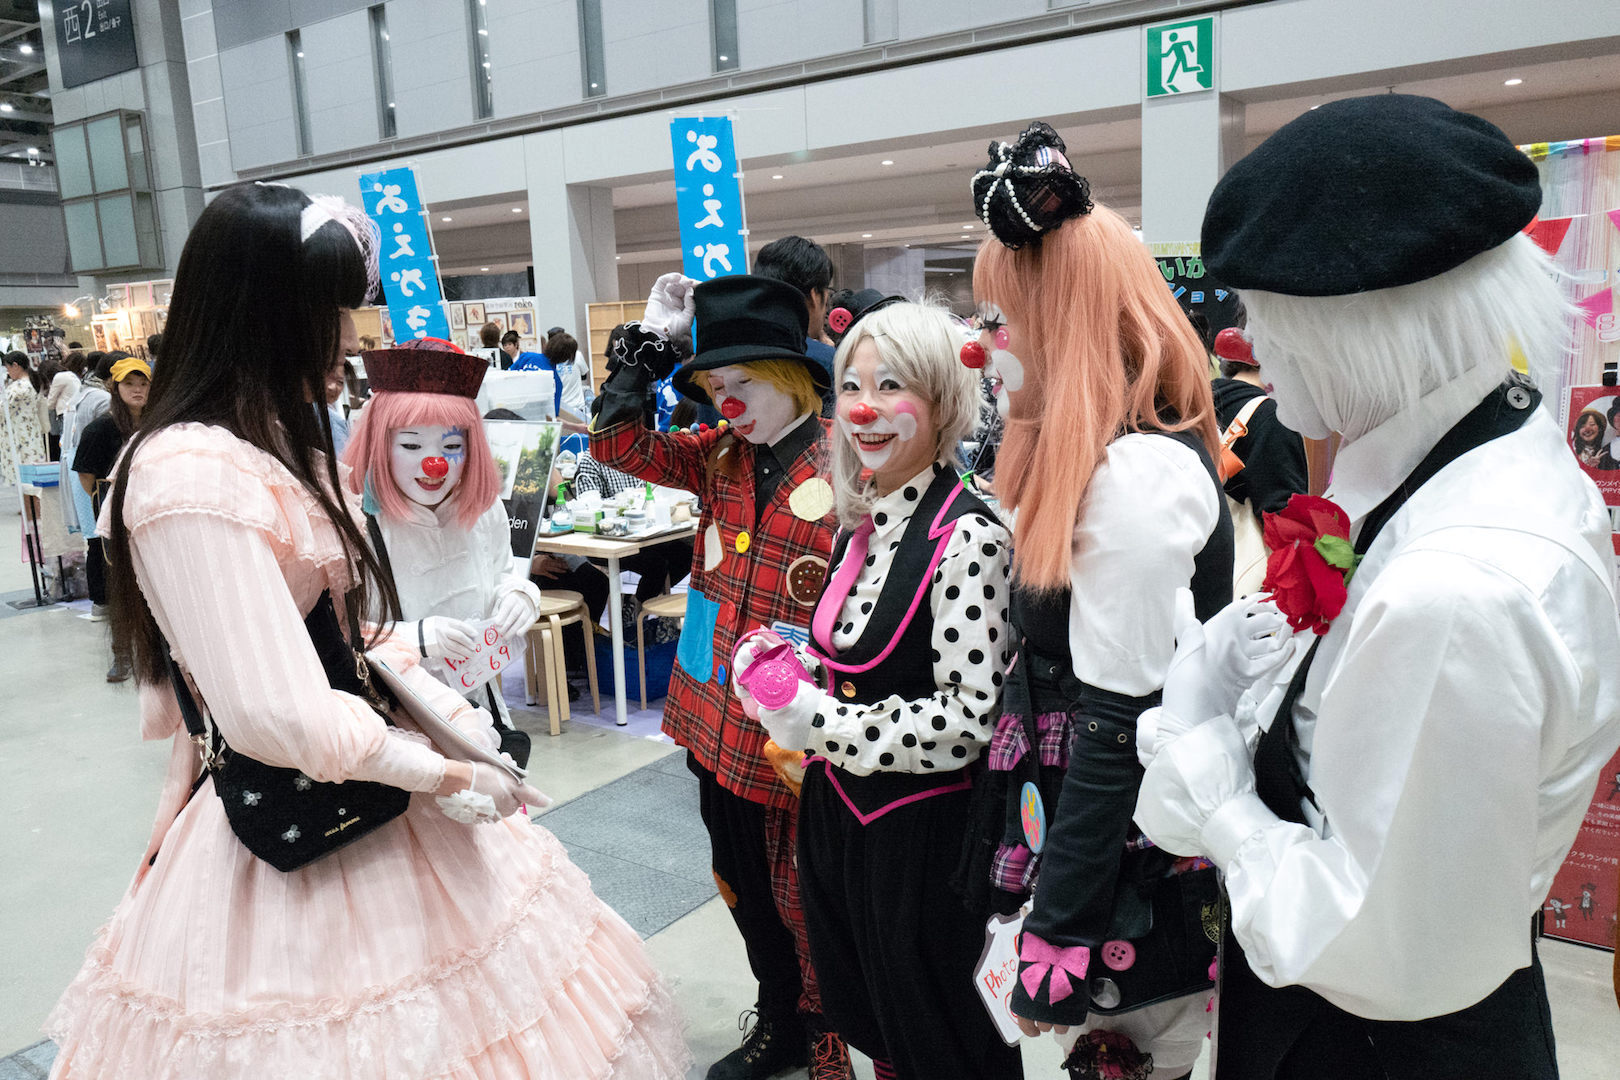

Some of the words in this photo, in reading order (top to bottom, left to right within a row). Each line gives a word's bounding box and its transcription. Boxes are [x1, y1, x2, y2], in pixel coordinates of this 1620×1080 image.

[686, 130, 732, 278] おえか
[984, 958, 1017, 999] Photo
